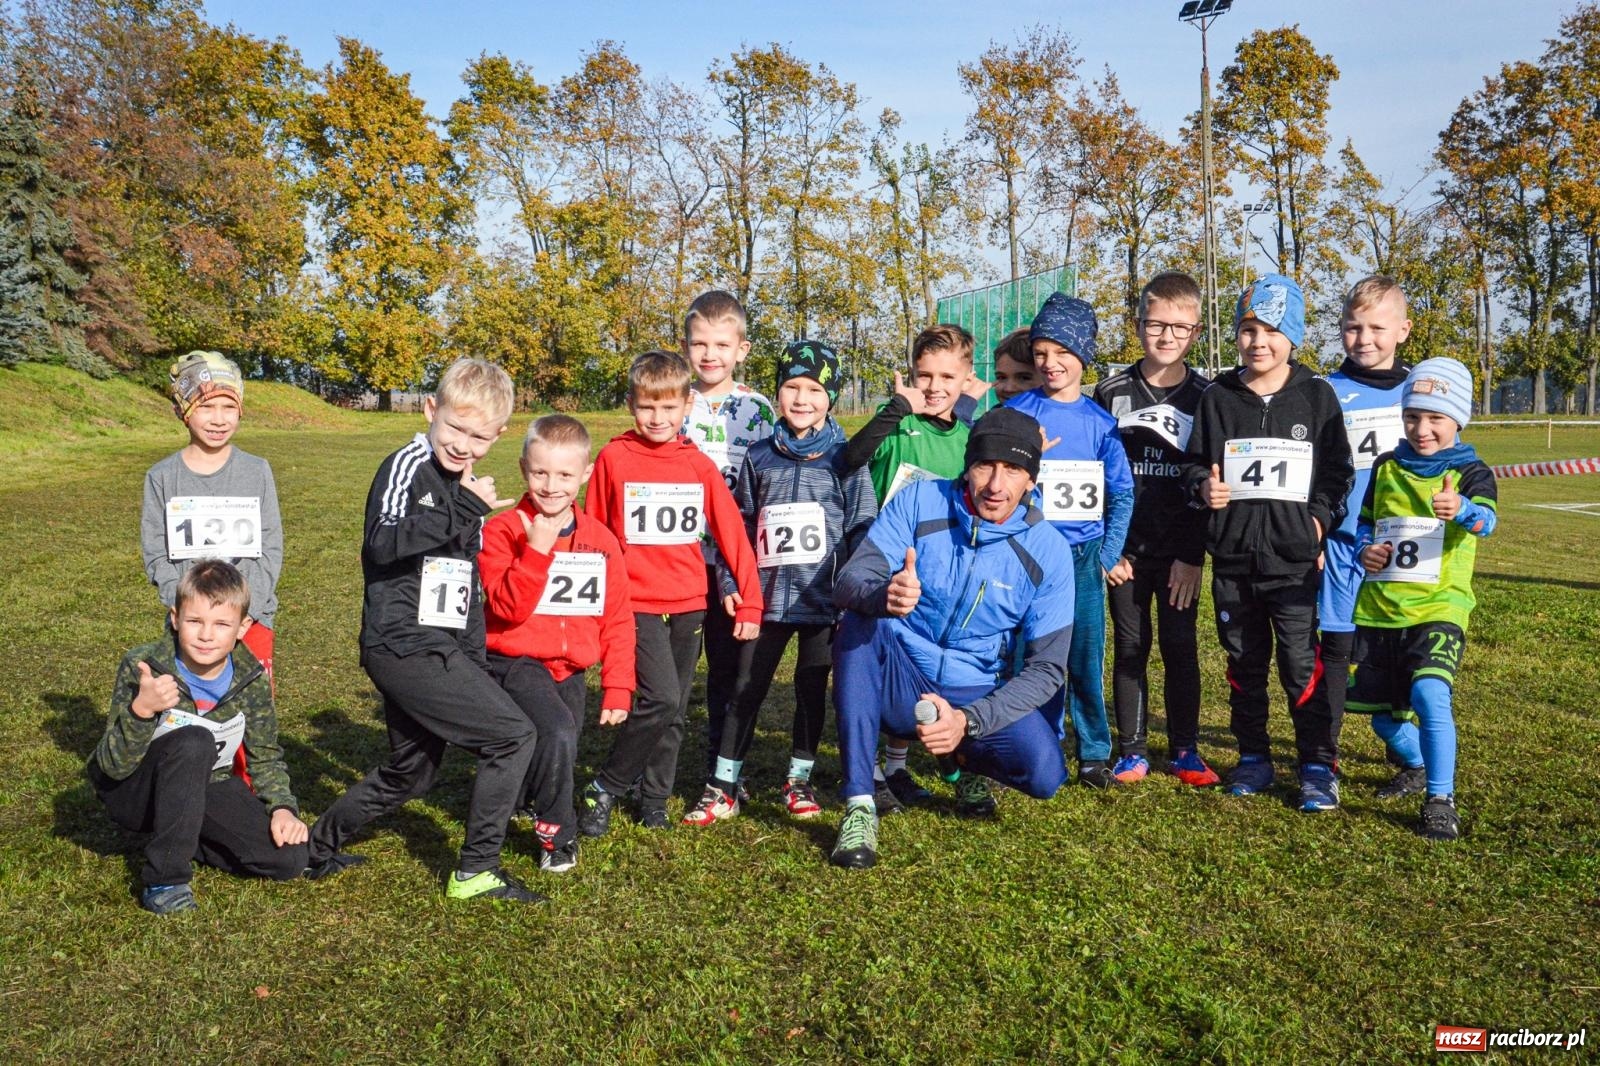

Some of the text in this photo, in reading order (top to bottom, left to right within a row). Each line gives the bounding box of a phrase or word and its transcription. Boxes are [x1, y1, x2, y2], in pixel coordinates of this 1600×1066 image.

[1138, 412, 1180, 436] 58
[1144, 446, 1163, 460] Fly
[1358, 431, 1381, 456] 4
[1241, 460, 1287, 487] 41
[175, 518, 255, 547] 120
[631, 505, 698, 533] 108
[760, 524, 821, 555] 126
[430, 583, 470, 616] 13
[550, 575, 600, 604] 24
[1429, 632, 1461, 662] 23
